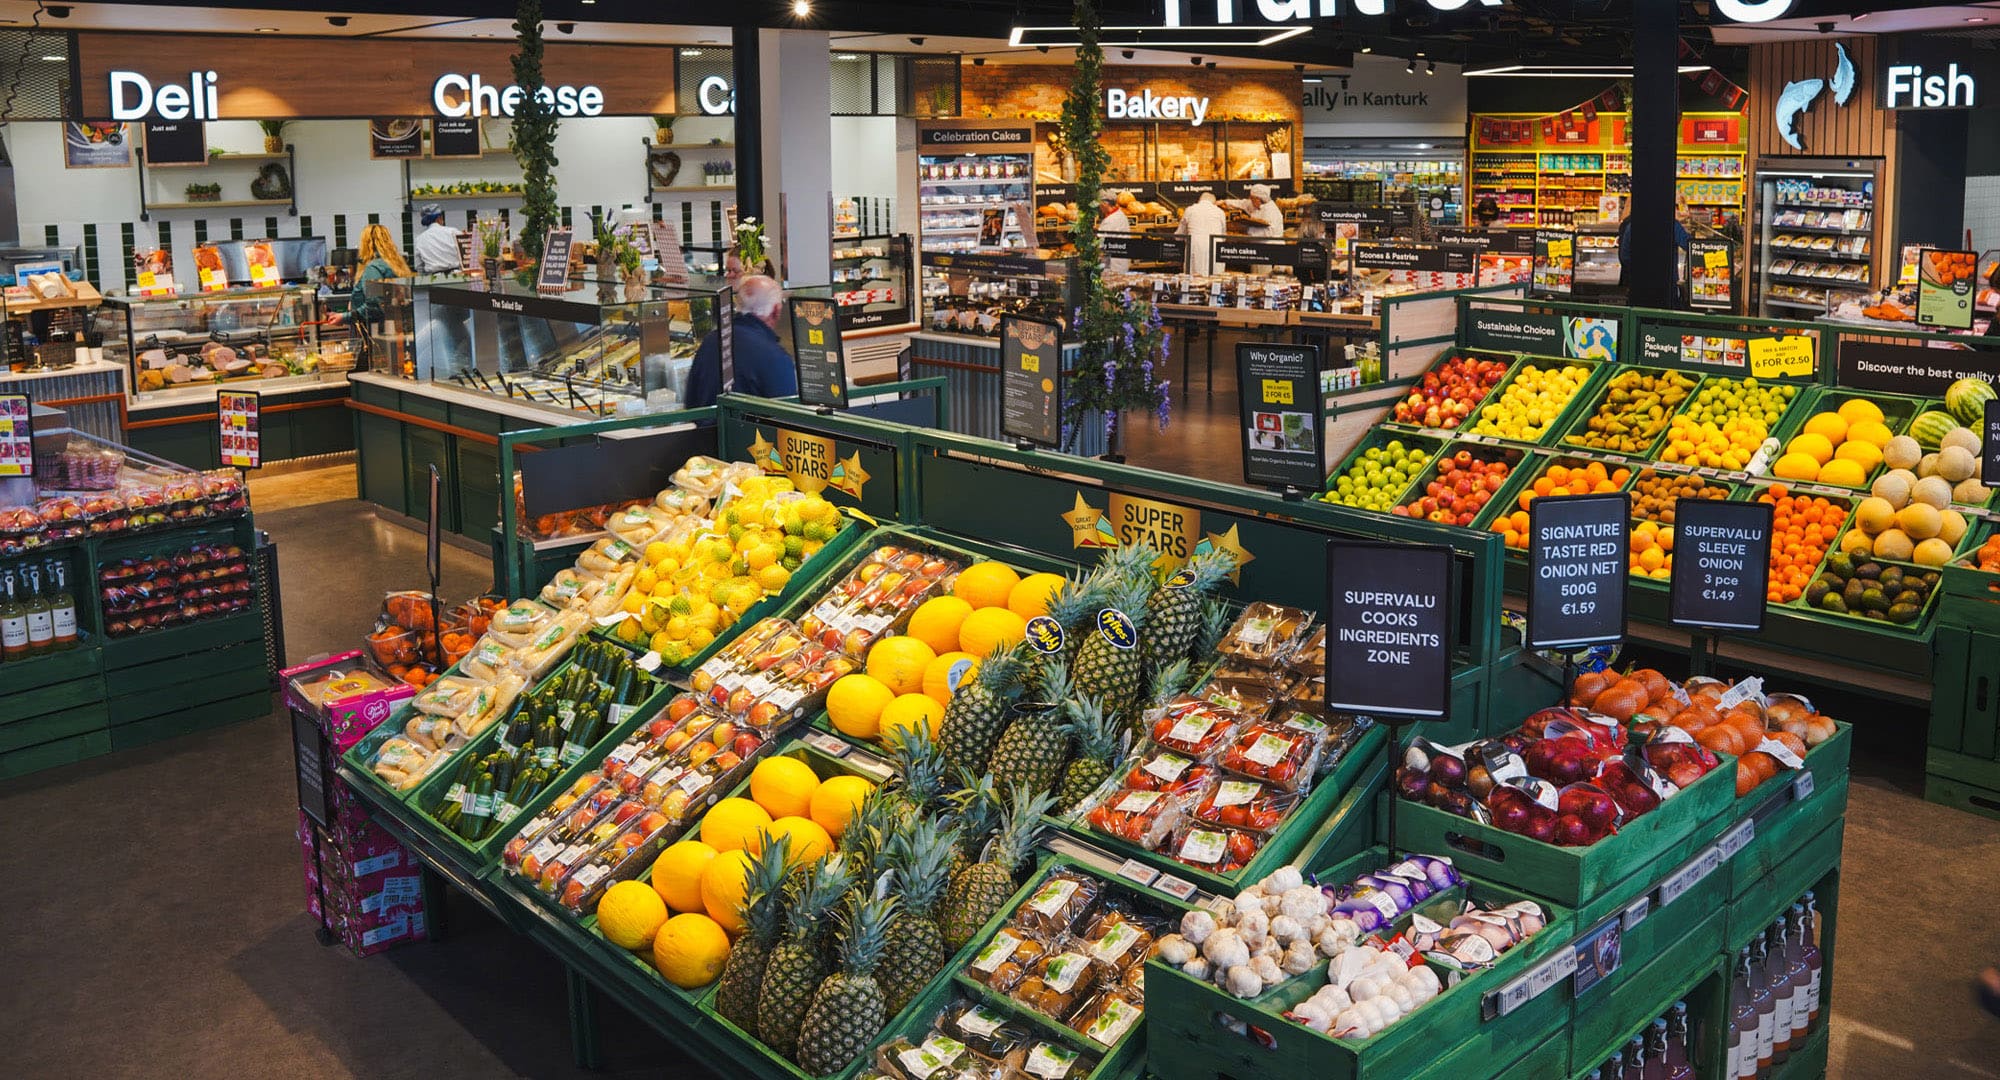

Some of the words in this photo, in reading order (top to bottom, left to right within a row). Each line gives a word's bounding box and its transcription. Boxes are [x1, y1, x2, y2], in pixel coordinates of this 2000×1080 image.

[1887, 63, 1975, 108] Fish
[110, 71, 218, 120] Deli
[1344, 92, 1357, 106] in
[1363, 91, 1428, 107] Kanturk
[1107, 88, 1209, 126] Bakery
[151, 124, 164, 132] Just
[933, 131, 990, 142] Celebration
[992, 131, 1021, 141] Cakes
[1442, 236, 1460, 244] Family
[1461, 236, 1490, 244] favourites
[1545, 232, 1572, 240] Packaging
[1220, 246, 1238, 254] Fresh
[1701, 244, 1728, 252] Packaging
[1360, 251, 1384, 260] Scones
[1392, 252, 1419, 261] Pastries
[492, 299, 501, 308] The
[501, 300, 514, 310] Salad
[514, 301, 524, 311] Bar
[1477, 320, 1521, 332] Sustainable
[1523, 324, 1555, 336] Choices
[1644, 334, 1655, 343] Go
[1644, 343, 1678, 353] Packaging
[1644, 350, 1660, 358] Free
[1250, 351, 1266, 363] Why
[1269, 352, 1304, 364] Organic?
[1762, 358, 1782, 366] FOR
[1784, 355, 1810, 365] €2.50
[1857, 360, 1904, 374] Discover
[1906, 365, 1924, 376] the
[1928, 366, 1952, 379] best
[1955, 370, 1995, 384] quality
[787, 437, 825, 459] SUPER
[785, 454, 828, 480] STARS
[1075, 516, 1091, 524] GREAT
[1124, 503, 1184, 533] SUPER
[1073, 523, 1096, 531] QUALITY
[1541, 523, 1620, 541] SIGNATURE
[1684, 525, 1762, 541] SUPERVALU
[1121, 525, 1187, 559] STARS
[1698, 542, 1746, 555] SLEEVE
[1542, 544, 1586, 560] TASTE
[1590, 542, 1616, 556] RED
[1540, 563, 1588, 579] ONION
[1592, 561, 1618, 575] NET
[1699, 558, 1743, 570] ONION
[1704, 574, 1712, 584] 3
[1715, 576, 1738, 587] pce
[1561, 581, 1597, 596] 500G
[1344, 591, 1436, 608] SUPERVALU
[1702, 590, 1735, 601] €1.49
[1561, 601, 1596, 615] €1.59
[1361, 611, 1418, 626] COOKS
[1102, 612, 1128, 640] Fyffes
[1340, 628, 1439, 647] INGREDIENTS
[1367, 650, 1410, 665] ZONE
[368, 703, 383, 715] Pink
[371, 708, 385, 719] Lady
